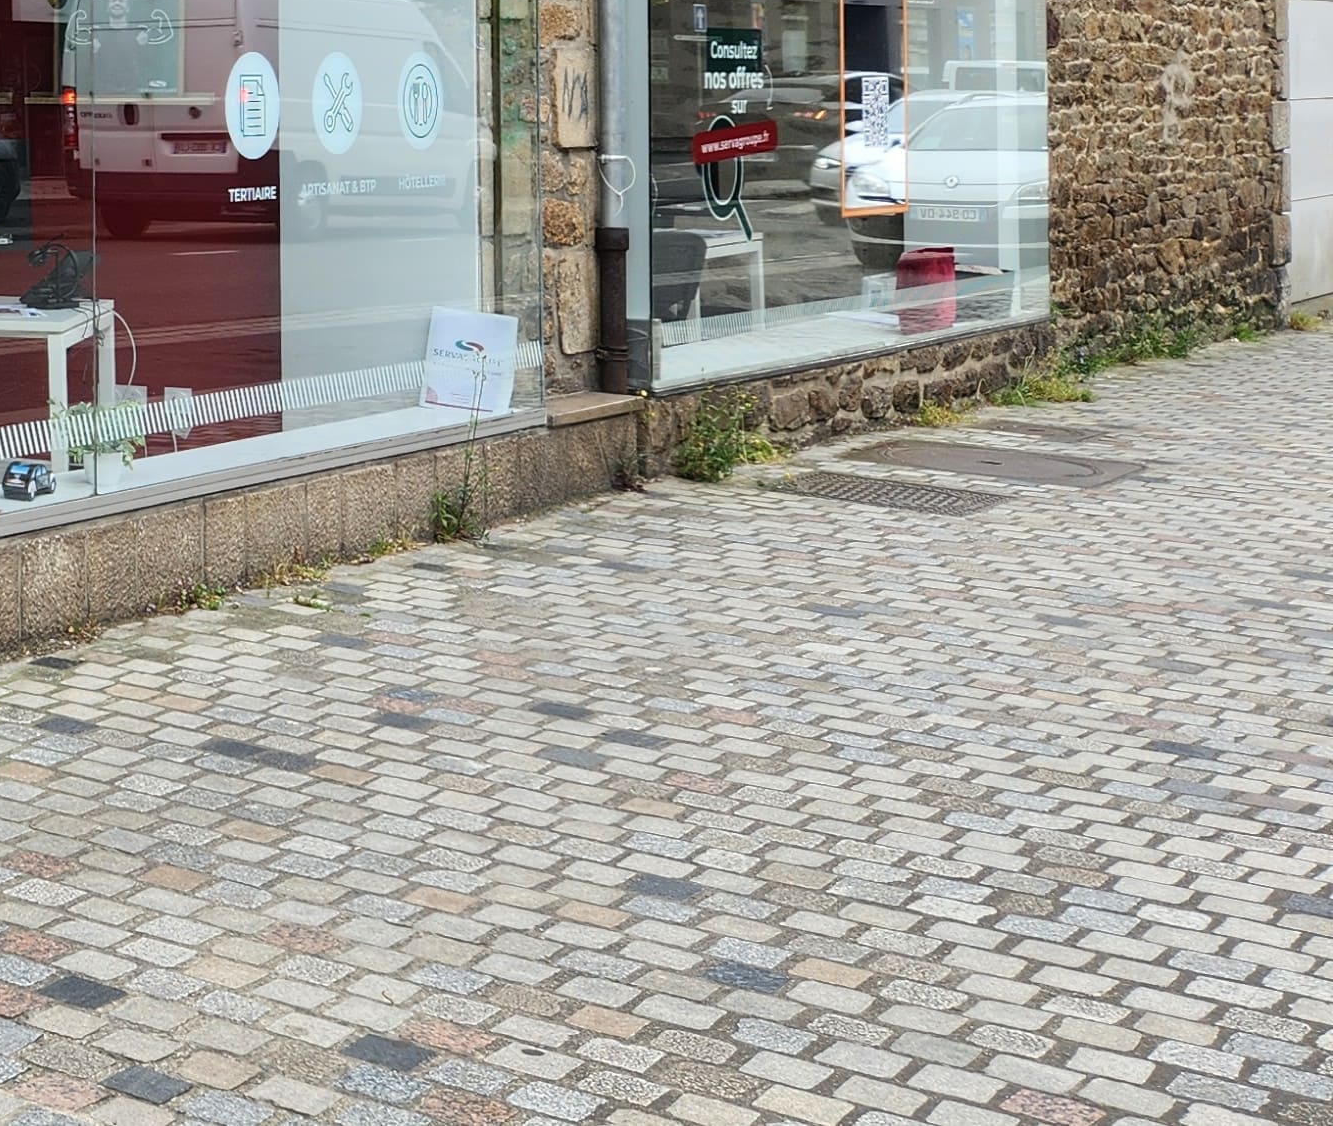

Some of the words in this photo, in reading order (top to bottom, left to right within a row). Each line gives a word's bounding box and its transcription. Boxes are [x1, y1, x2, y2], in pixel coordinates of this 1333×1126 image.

[711, 41, 758, 59] Consultez
[704, 72, 727, 89] nos
[729, 66, 764, 89] offres
[731, 100, 748, 114] sur
[701, 130, 770, 154] www.servagroupe.fr
[228, 186, 277, 202] TERTIAIRE
[300, 181, 351, 197] ARTISANAT
[359, 179, 376, 193] BTP
